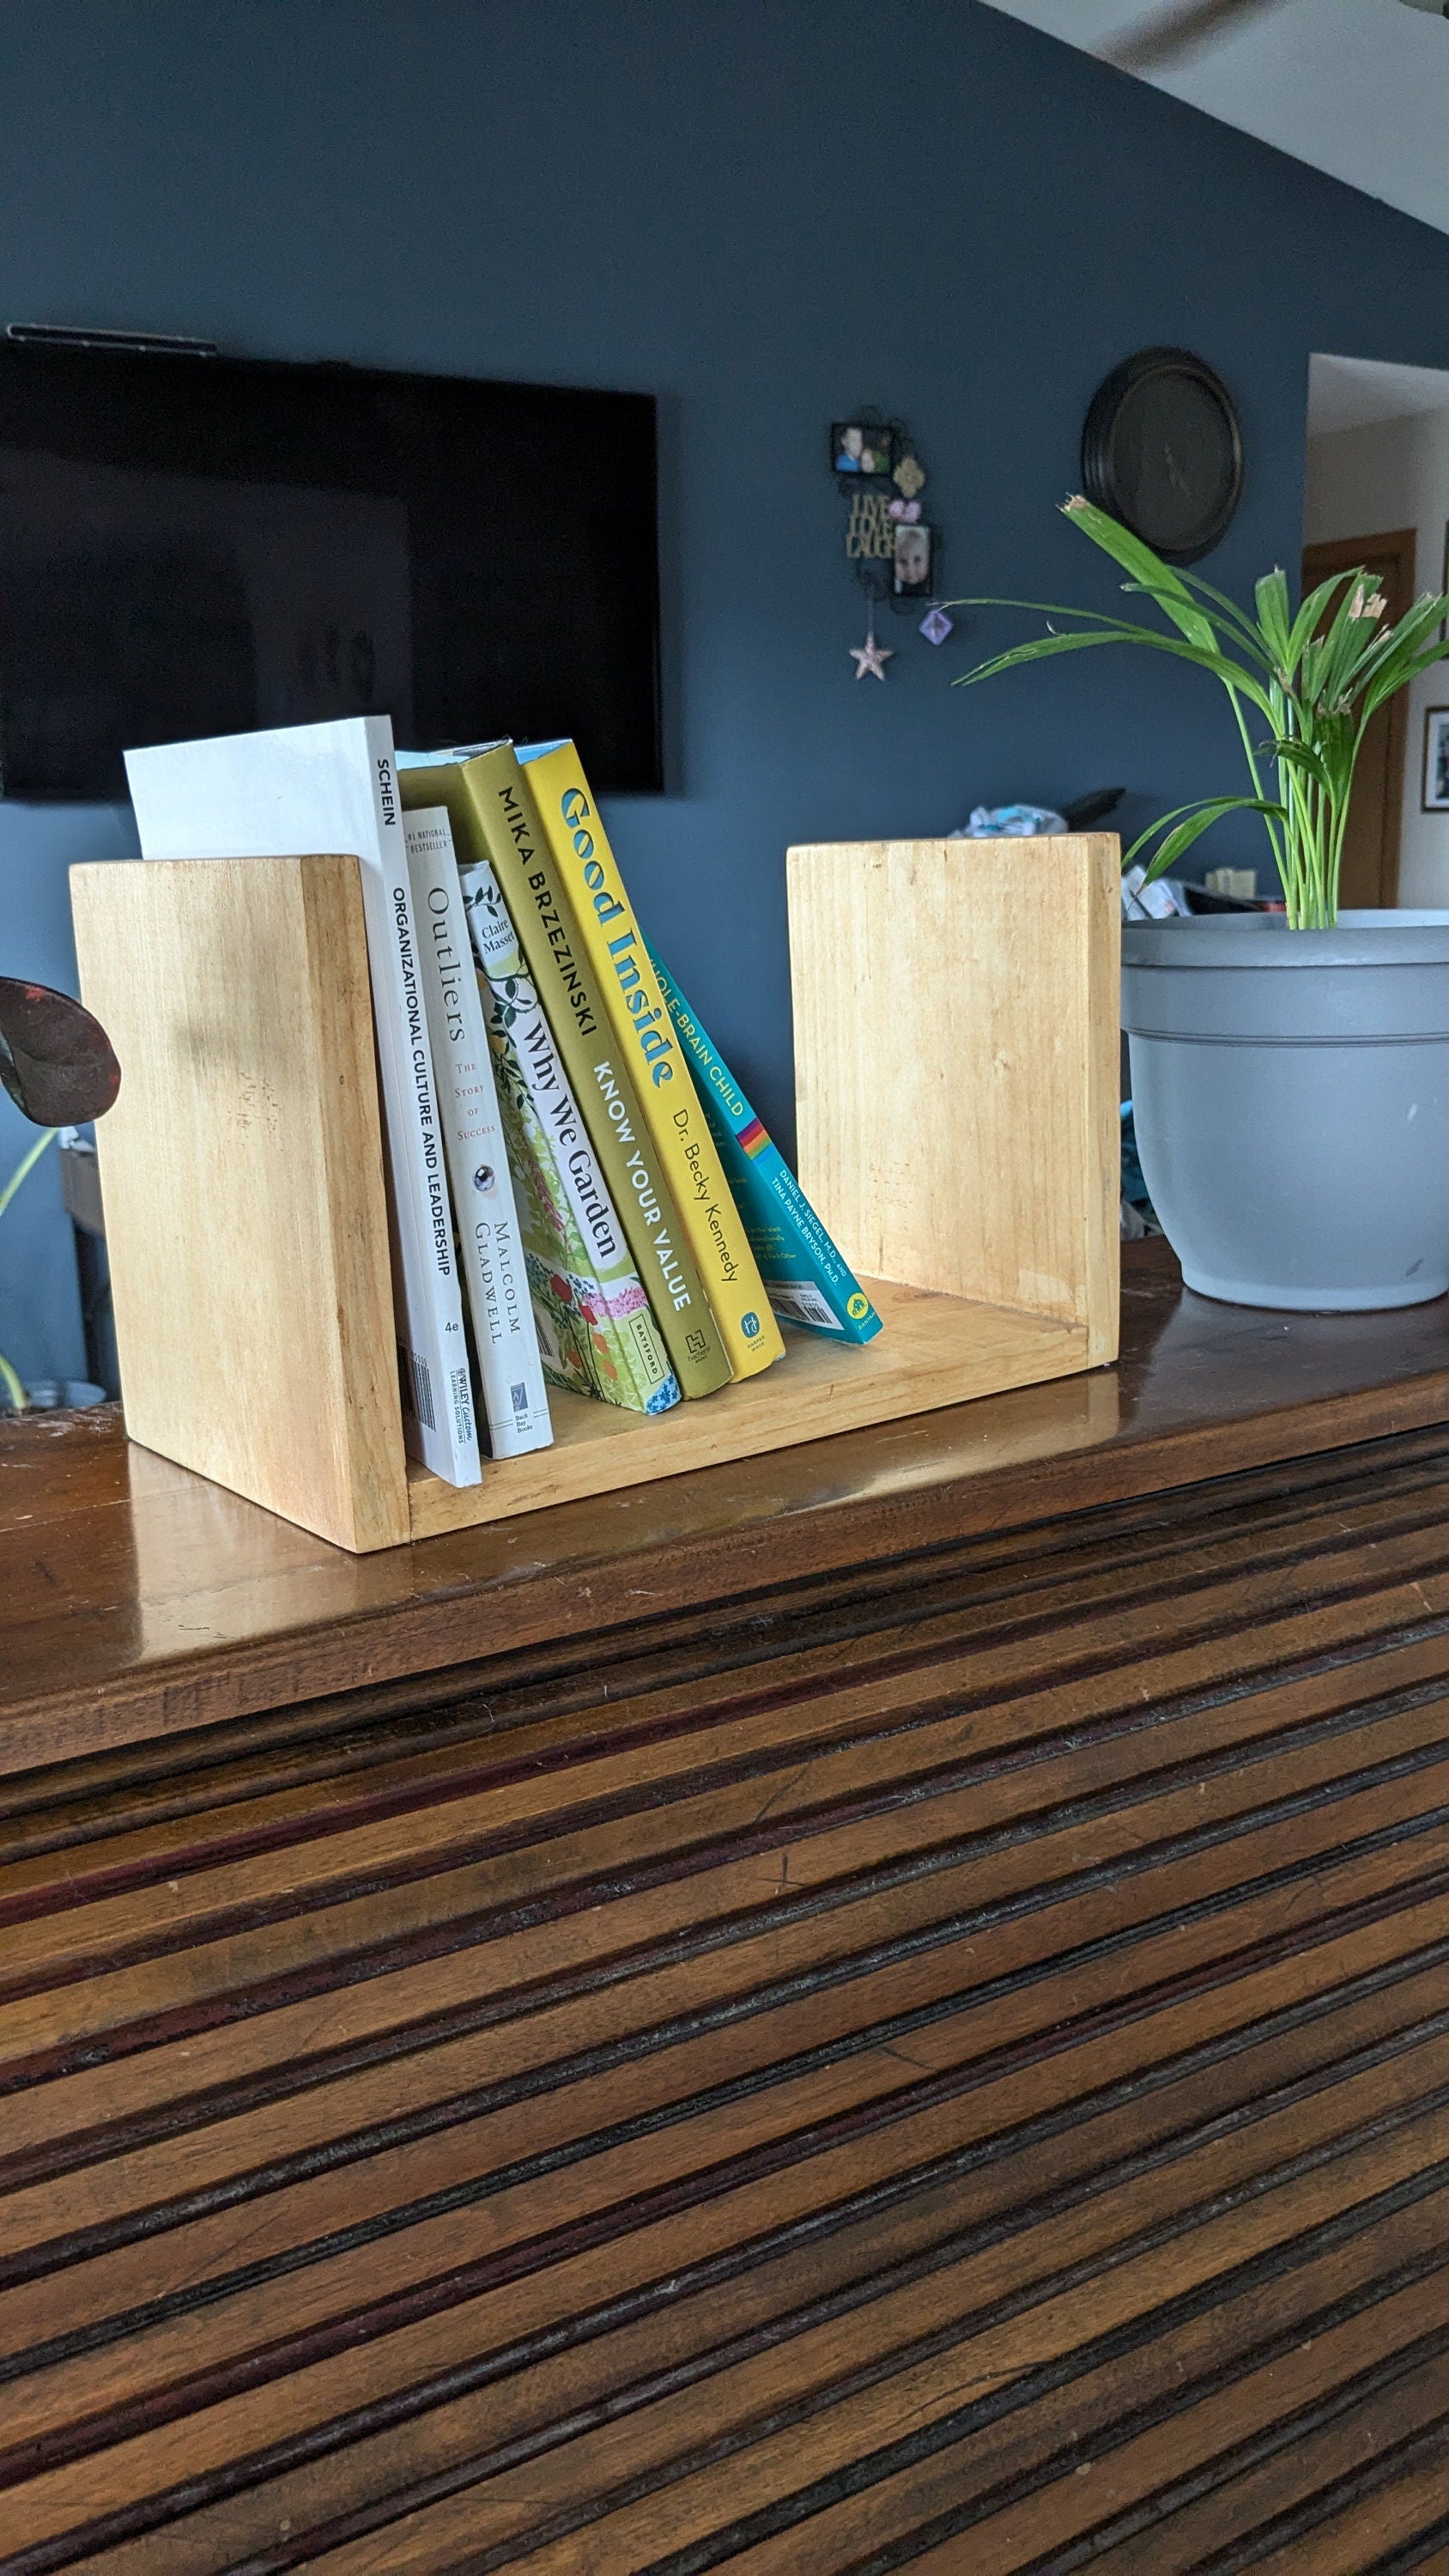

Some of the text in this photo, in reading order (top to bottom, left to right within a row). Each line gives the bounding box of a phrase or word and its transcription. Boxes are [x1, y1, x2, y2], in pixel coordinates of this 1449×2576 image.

[378, 759, 396, 826] SCHEIN
[408, 828, 446, 841] #1 NATIONAL
[409, 840, 448, 854] BESTSELLER
[482, 919, 509, 939] Claire
[483, 931, 515, 954] Masset
[498, 786, 597, 1036] MIKA BRZEZINSKI
[561, 787, 674, 1088] Good Inside
[428, 887, 465, 1042] Outliers
[393, 887, 451, 1276] ORGANIZATIONAL CULTURE AND LEADERSHIP
[709, 1066, 744, 1116] CHILD
[524, 1019, 616, 1259] Why We Garden
[593, 1060, 692, 1312] KNOW YOUR VALUE
[672, 1108, 689, 1142] Dr.
[684, 1142, 711, 1200] Becky
[705, 1203, 739, 1283] Kennedy
[772, 1177, 839, 1286] TINA PAYNE BRYSON, PH.D.
[779, 1169, 847, 1278] DANIEL J. SIEGEL, M.D., AND
[475, 1222, 502, 1344] GLADWELL
[494, 1221, 521, 1333] MALCOLM
[445, 1321, 459, 1333] 4e
[636, 1323, 658, 1375] BATSFORD
[687, 1346, 712, 1362] hachette
[450, 1370, 464, 1444] LEARNING SOLUTIONS
[458, 1376, 473, 1441] WILEY Custom
[515, 1413, 528, 1421] Back
[517, 1425, 533, 1433] Books
